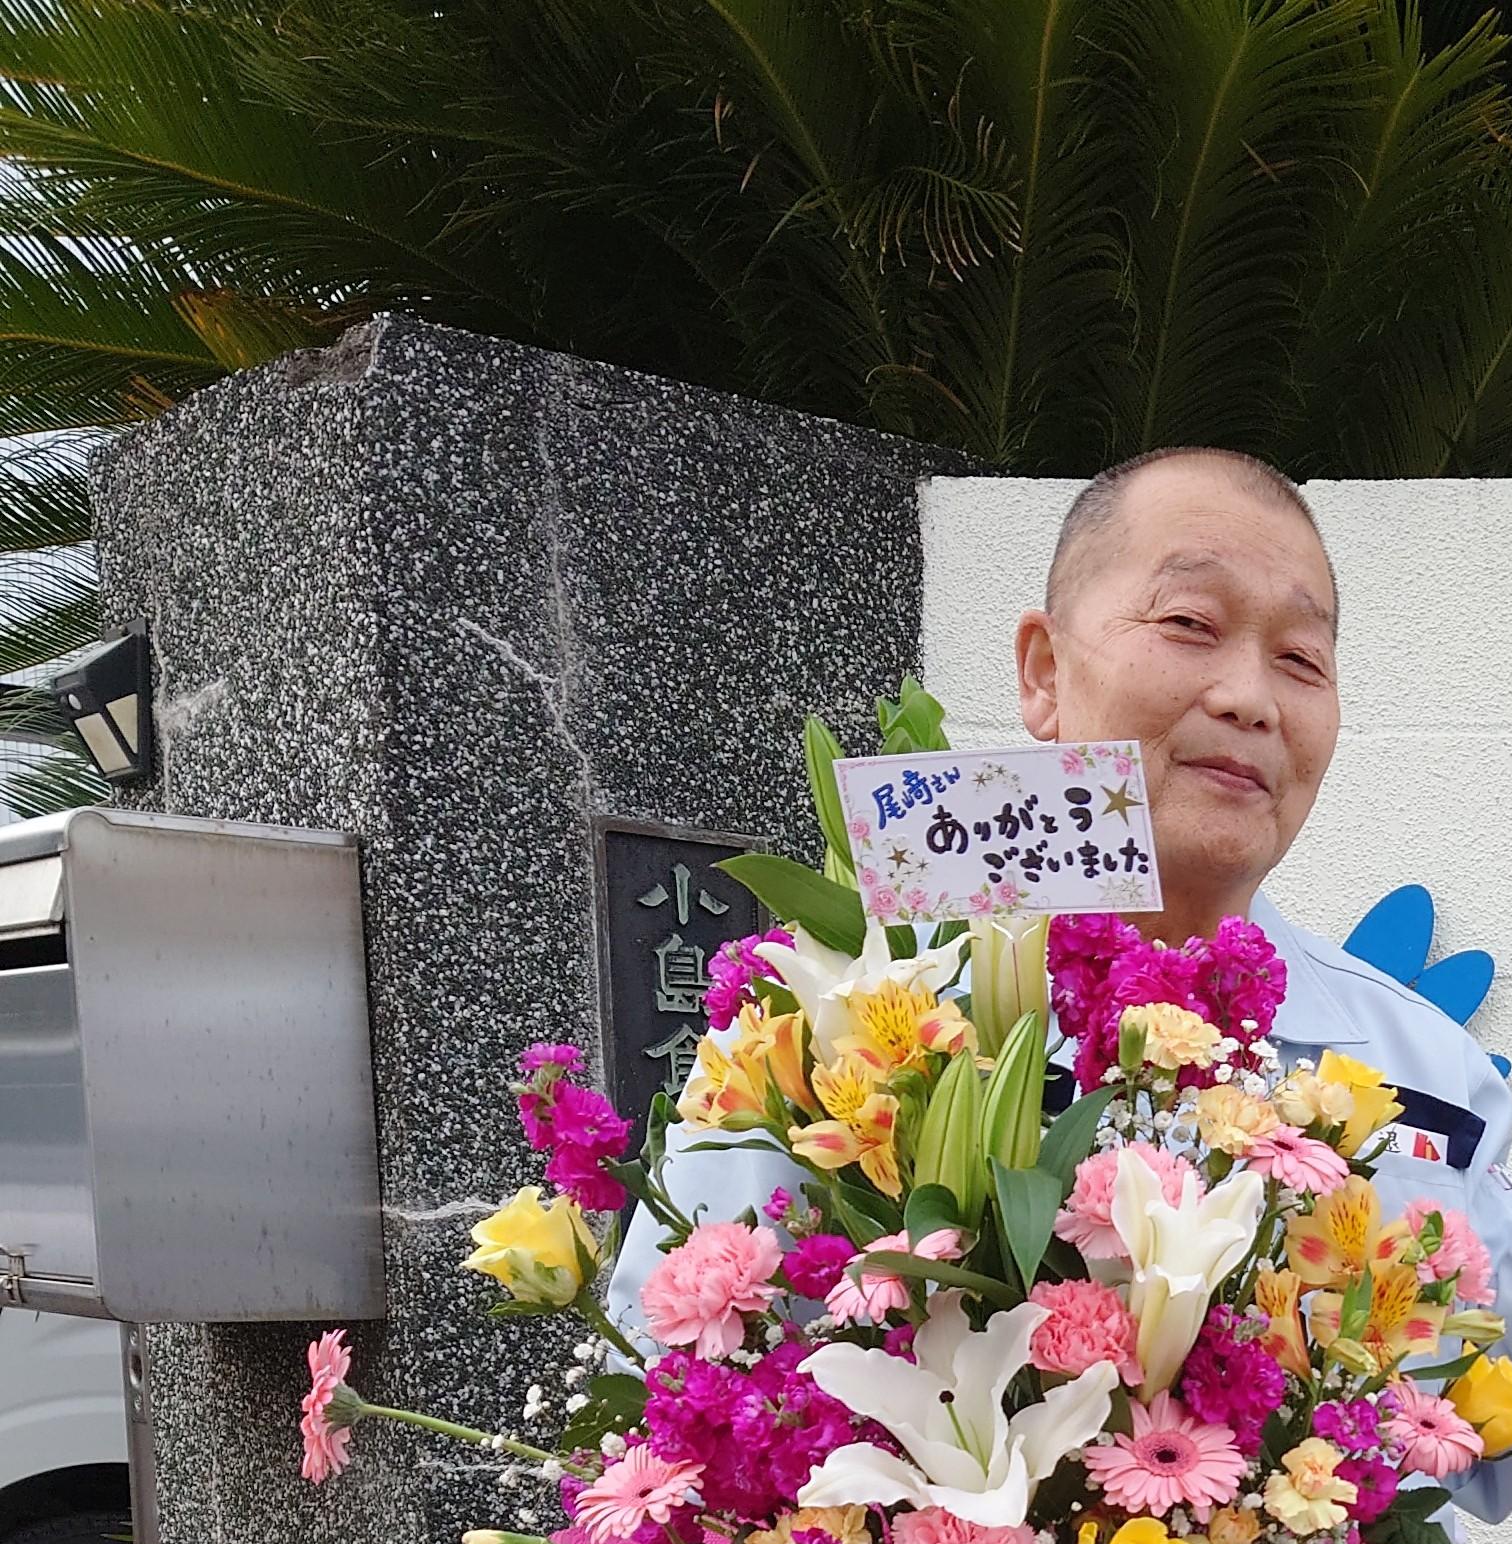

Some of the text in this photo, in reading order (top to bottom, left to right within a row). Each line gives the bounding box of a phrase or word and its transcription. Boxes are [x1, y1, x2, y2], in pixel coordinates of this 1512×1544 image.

[926, 786, 1093, 854] ありがとう
[982, 837, 1149, 883] ございました
